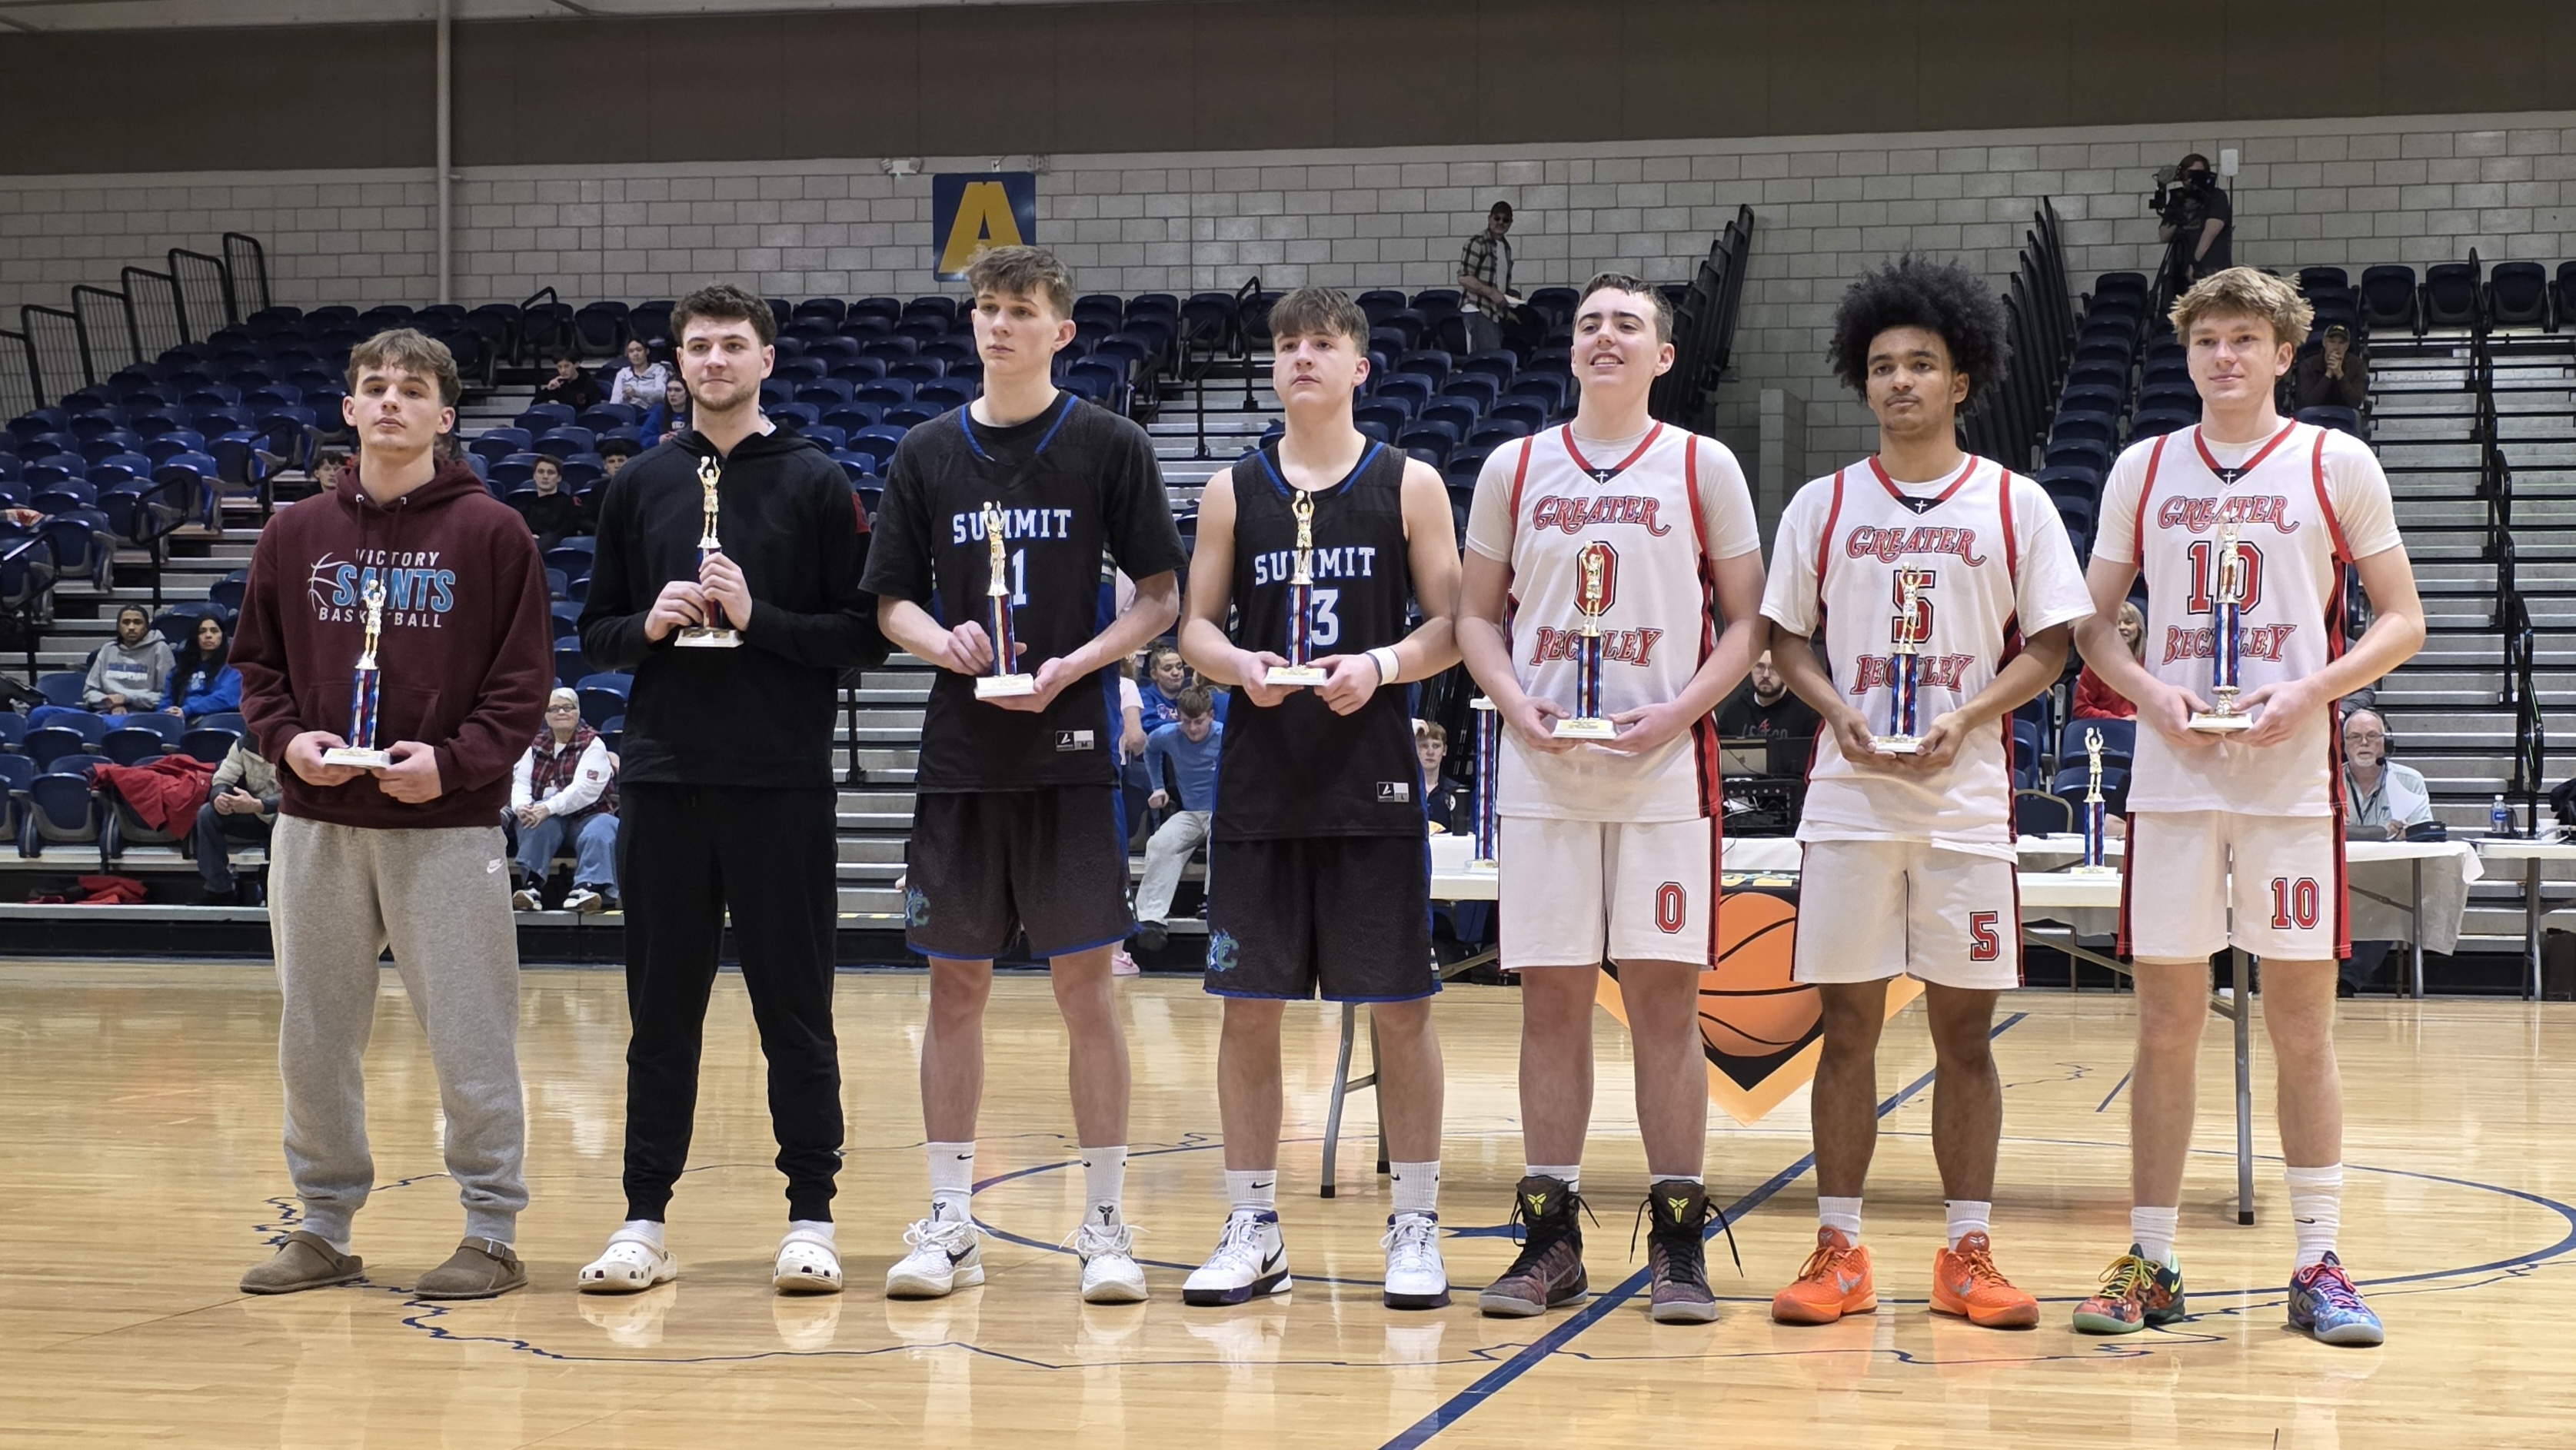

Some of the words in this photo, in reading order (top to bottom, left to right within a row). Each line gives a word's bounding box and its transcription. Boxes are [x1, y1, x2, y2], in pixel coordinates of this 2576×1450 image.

[938, 181, 1024, 273] A
[1533, 496, 1671, 536] GREATER
[2158, 495, 2300, 534] GREATER
[1845, 526, 1986, 567] GREATER
[1573, 540, 1619, 617] 0
[2187, 540, 2263, 615] 10
[318, 607, 441, 628] BASKBALL
[1891, 570, 1935, 644] 5
[1529, 627, 1663, 667] BECLEY
[2157, 624, 2298, 665] BECLEY
[1849, 653, 1975, 695] BECLEY
[1656, 881, 1686, 934] 0
[2271, 876, 2320, 930] 10
[1970, 910, 2000, 962] 5
